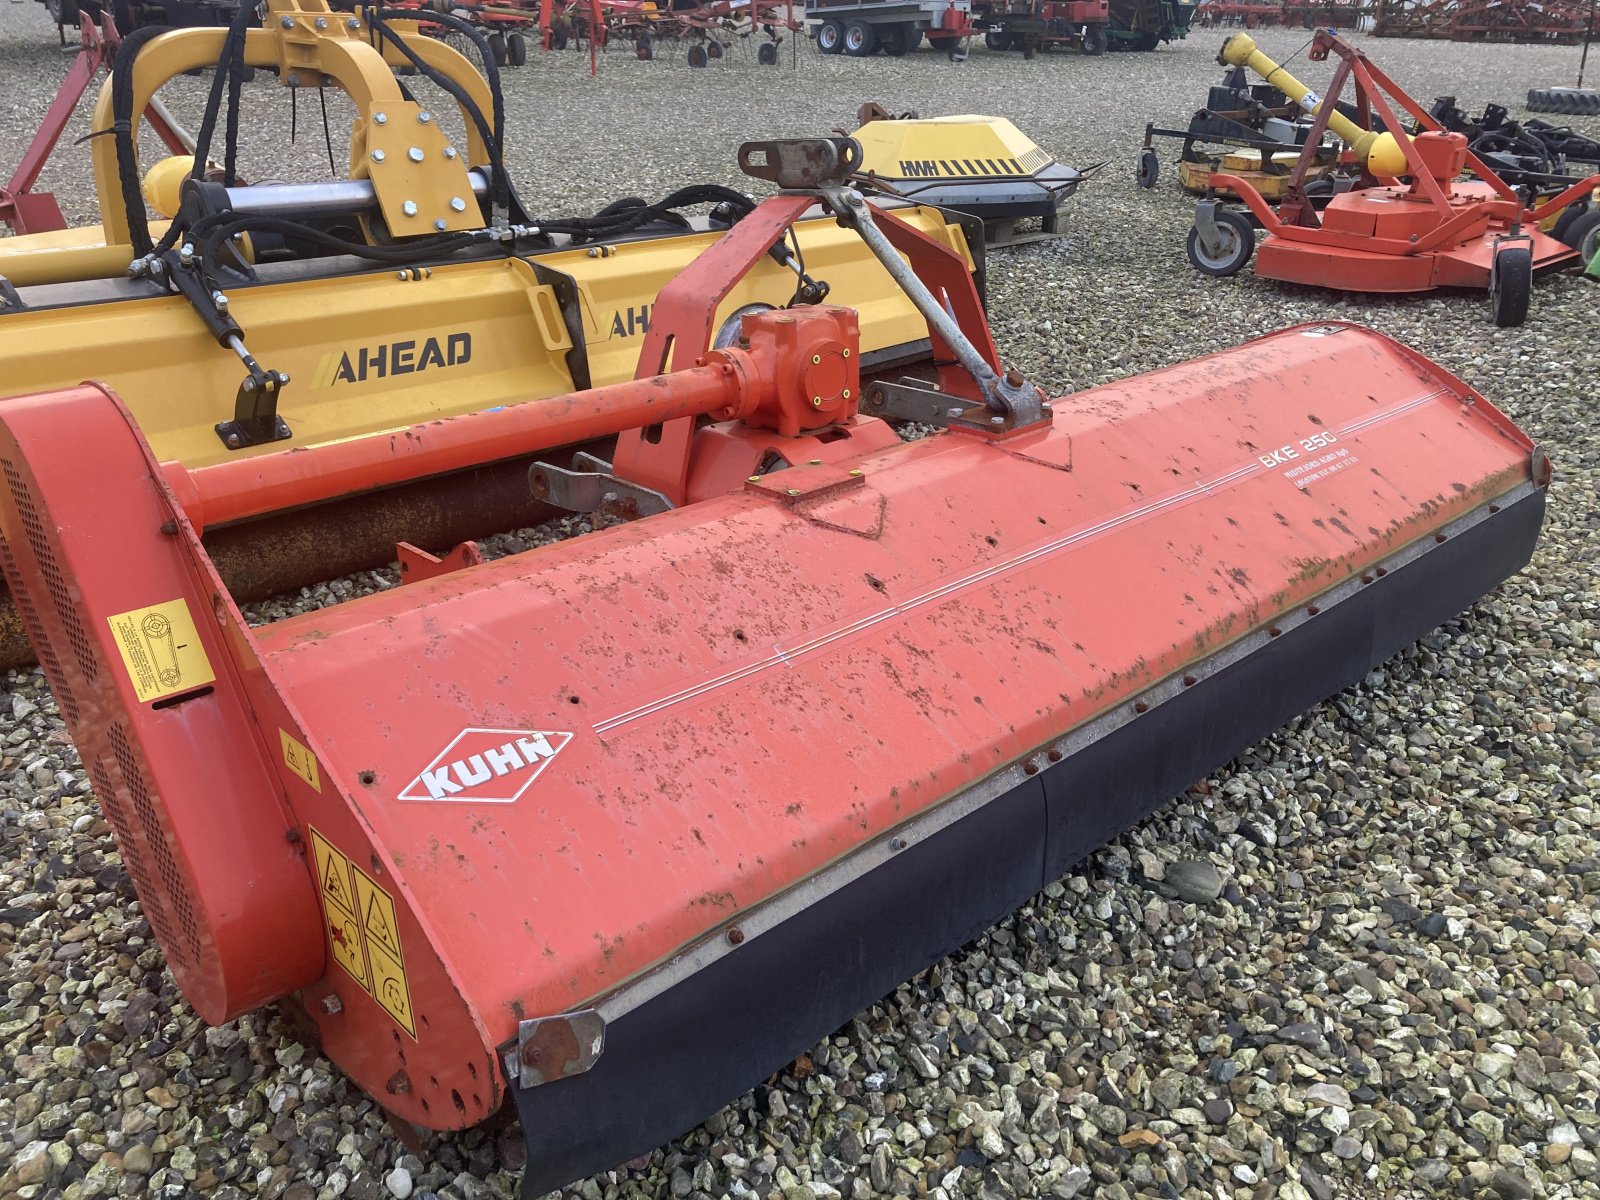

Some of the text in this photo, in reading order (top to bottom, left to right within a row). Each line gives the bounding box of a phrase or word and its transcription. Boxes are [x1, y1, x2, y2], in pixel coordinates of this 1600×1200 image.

[899, 160, 940, 177] HWH
[609, 303, 654, 338] AH
[331, 332, 472, 387] AHEAD
[1258, 431, 1338, 469] BKE 250
[420, 731, 556, 800] KUHN
